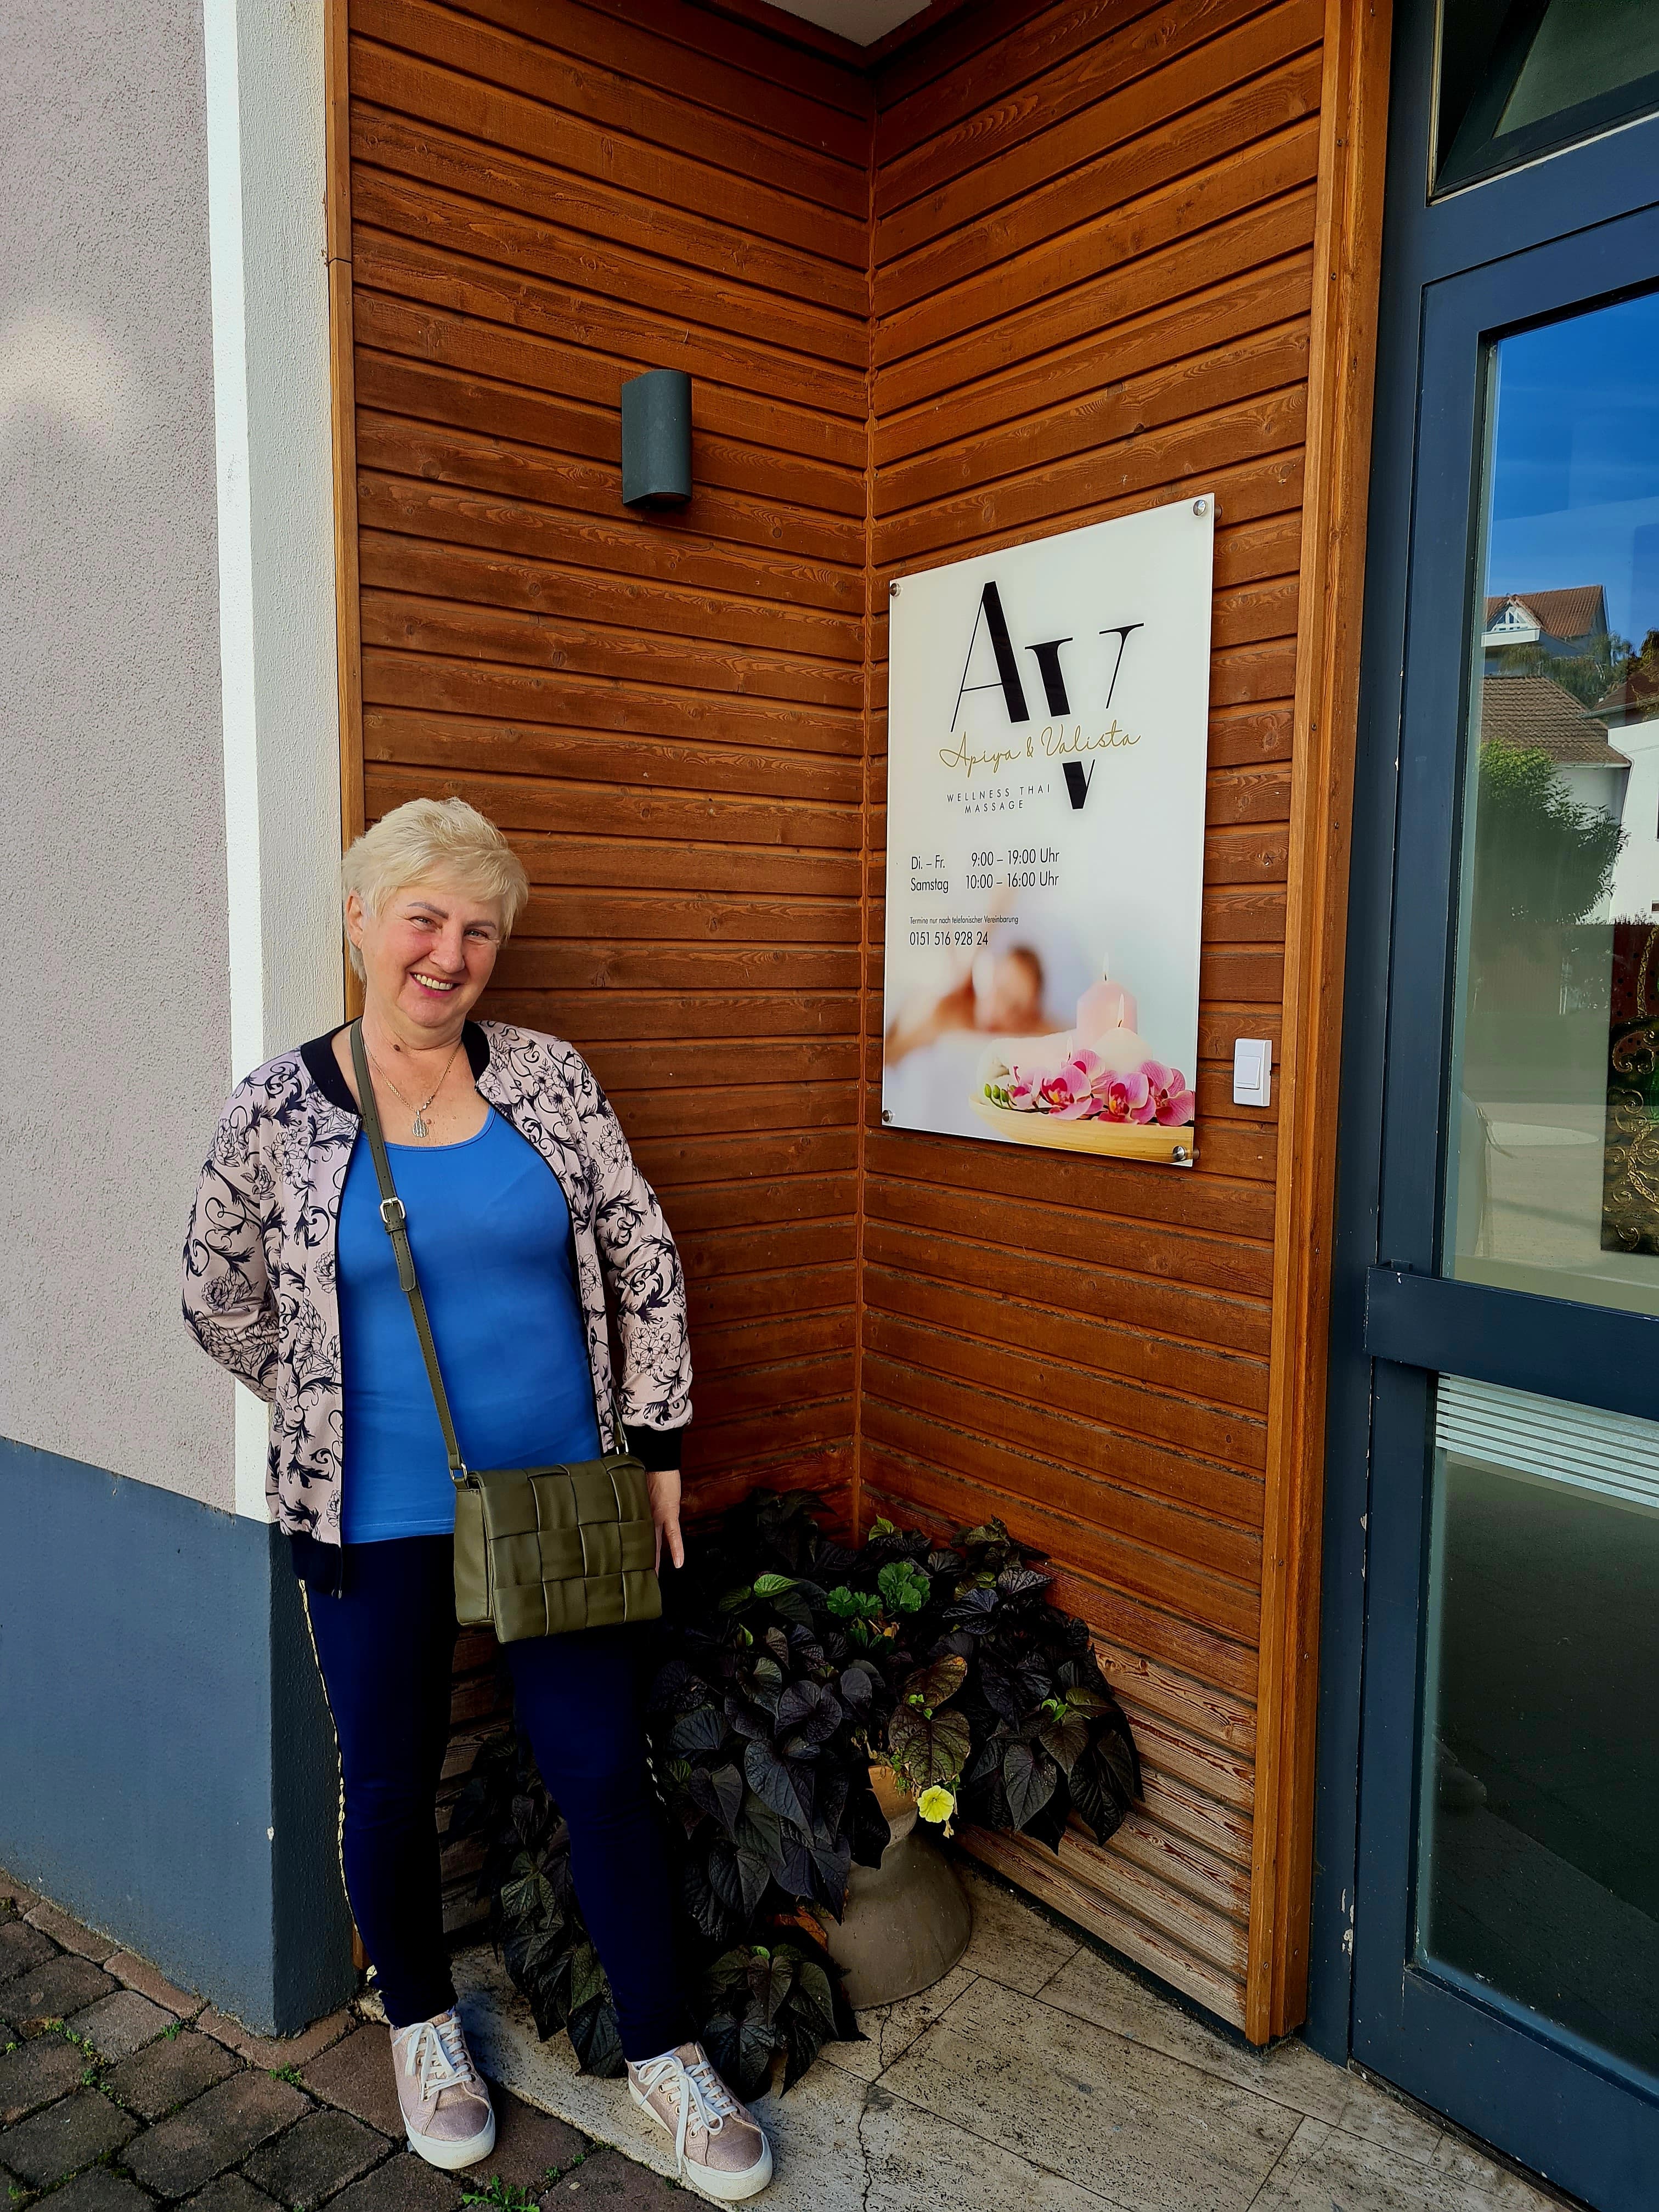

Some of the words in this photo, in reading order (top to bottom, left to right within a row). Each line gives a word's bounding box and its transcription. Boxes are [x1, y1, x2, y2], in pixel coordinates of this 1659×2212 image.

[939, 731, 1021, 778] Apiya
[1026, 736, 1034, 758] &
[1041, 719, 1141, 757] Valista
[947, 788, 1010, 803] WELLNESS
[1019, 783, 1050, 796] THAI
[965, 799, 1024, 814] MASSAGE
[911, 856, 923, 870] Di.
[935, 855, 945, 868] Fr.
[971, 851, 994, 867] 9:00
[1008, 849, 1036, 865] 19:00
[1040, 847, 1060, 863] Uhr
[911, 877, 949, 893] Samstag
[966, 874, 993, 889] 10:00
[1007, 872, 1036, 887] 16:00
[1040, 870, 1059, 886] Uhr
[939, 916, 951, 924] nach
[952, 915, 983, 924] telefonischer
[984, 915, 1019, 925] Vereinbarung
[910, 932, 929, 945] 0151
[934, 932, 951, 945] 516
[955, 931, 973, 945] 928
[977, 931, 988, 945] 24
